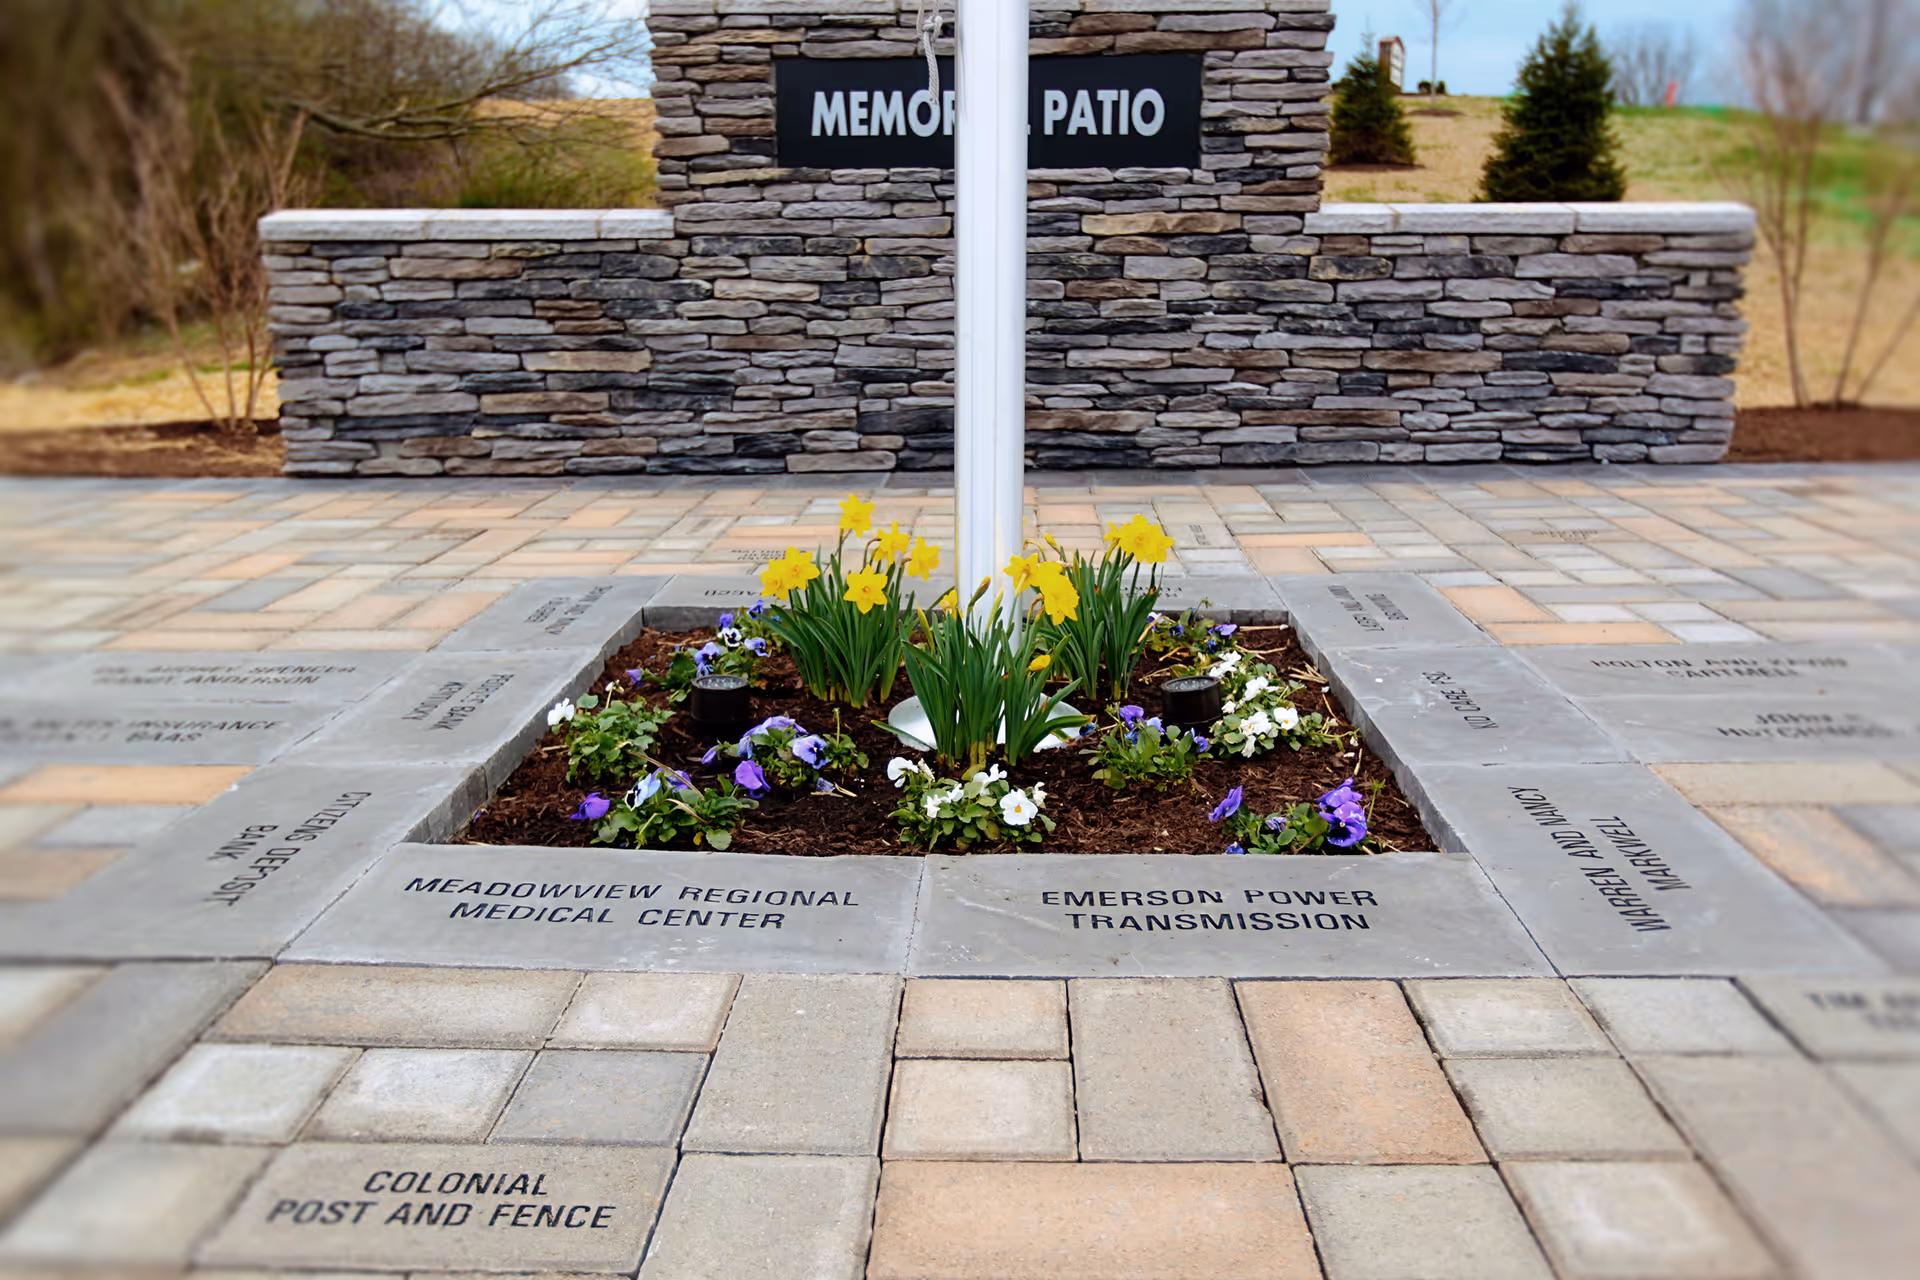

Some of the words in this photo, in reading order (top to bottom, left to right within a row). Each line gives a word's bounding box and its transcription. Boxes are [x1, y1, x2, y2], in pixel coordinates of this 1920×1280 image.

[1044, 88, 1165, 137] PATIO
[248, 664, 357, 675] SPENCER
[1591, 659, 1692, 669] HOLTON
[184, 674, 321, 686] ANDERSON
[401, 681, 467, 720] KENTUCKY
[1440, 689, 1481, 712] CARE
[126, 719, 284, 731] INSURANCE
[429, 705, 477, 730] BANK
[1463, 715, 1499, 730] KID
[284, 791, 373, 842] CITIZENS
[1507, 786, 1572, 826] NANCY
[207, 824, 280, 861] BANK
[1550, 830, 1604, 859] AND
[1589, 815, 1692, 891] MARKWELL
[203, 847, 302, 907] DEPOSIT
[404, 876, 662, 900] MEADOWVIEW
[678, 885, 860, 906] REGIONAL
[1042, 889, 1224, 907] EMERSON
[1244, 889, 1379, 907] POWER
[1579, 867, 1672, 932] WARREN
[449, 901, 615, 924] MEDICAL
[638, 908, 786, 929] CENTER
[1064, 912, 1371, 931] TRANSMISSION
[363, 1170, 549, 1196] COLONIAL
[266, 1200, 379, 1225] POST
[384, 1202, 473, 1227] AND
[488, 1204, 617, 1229] FENCE
